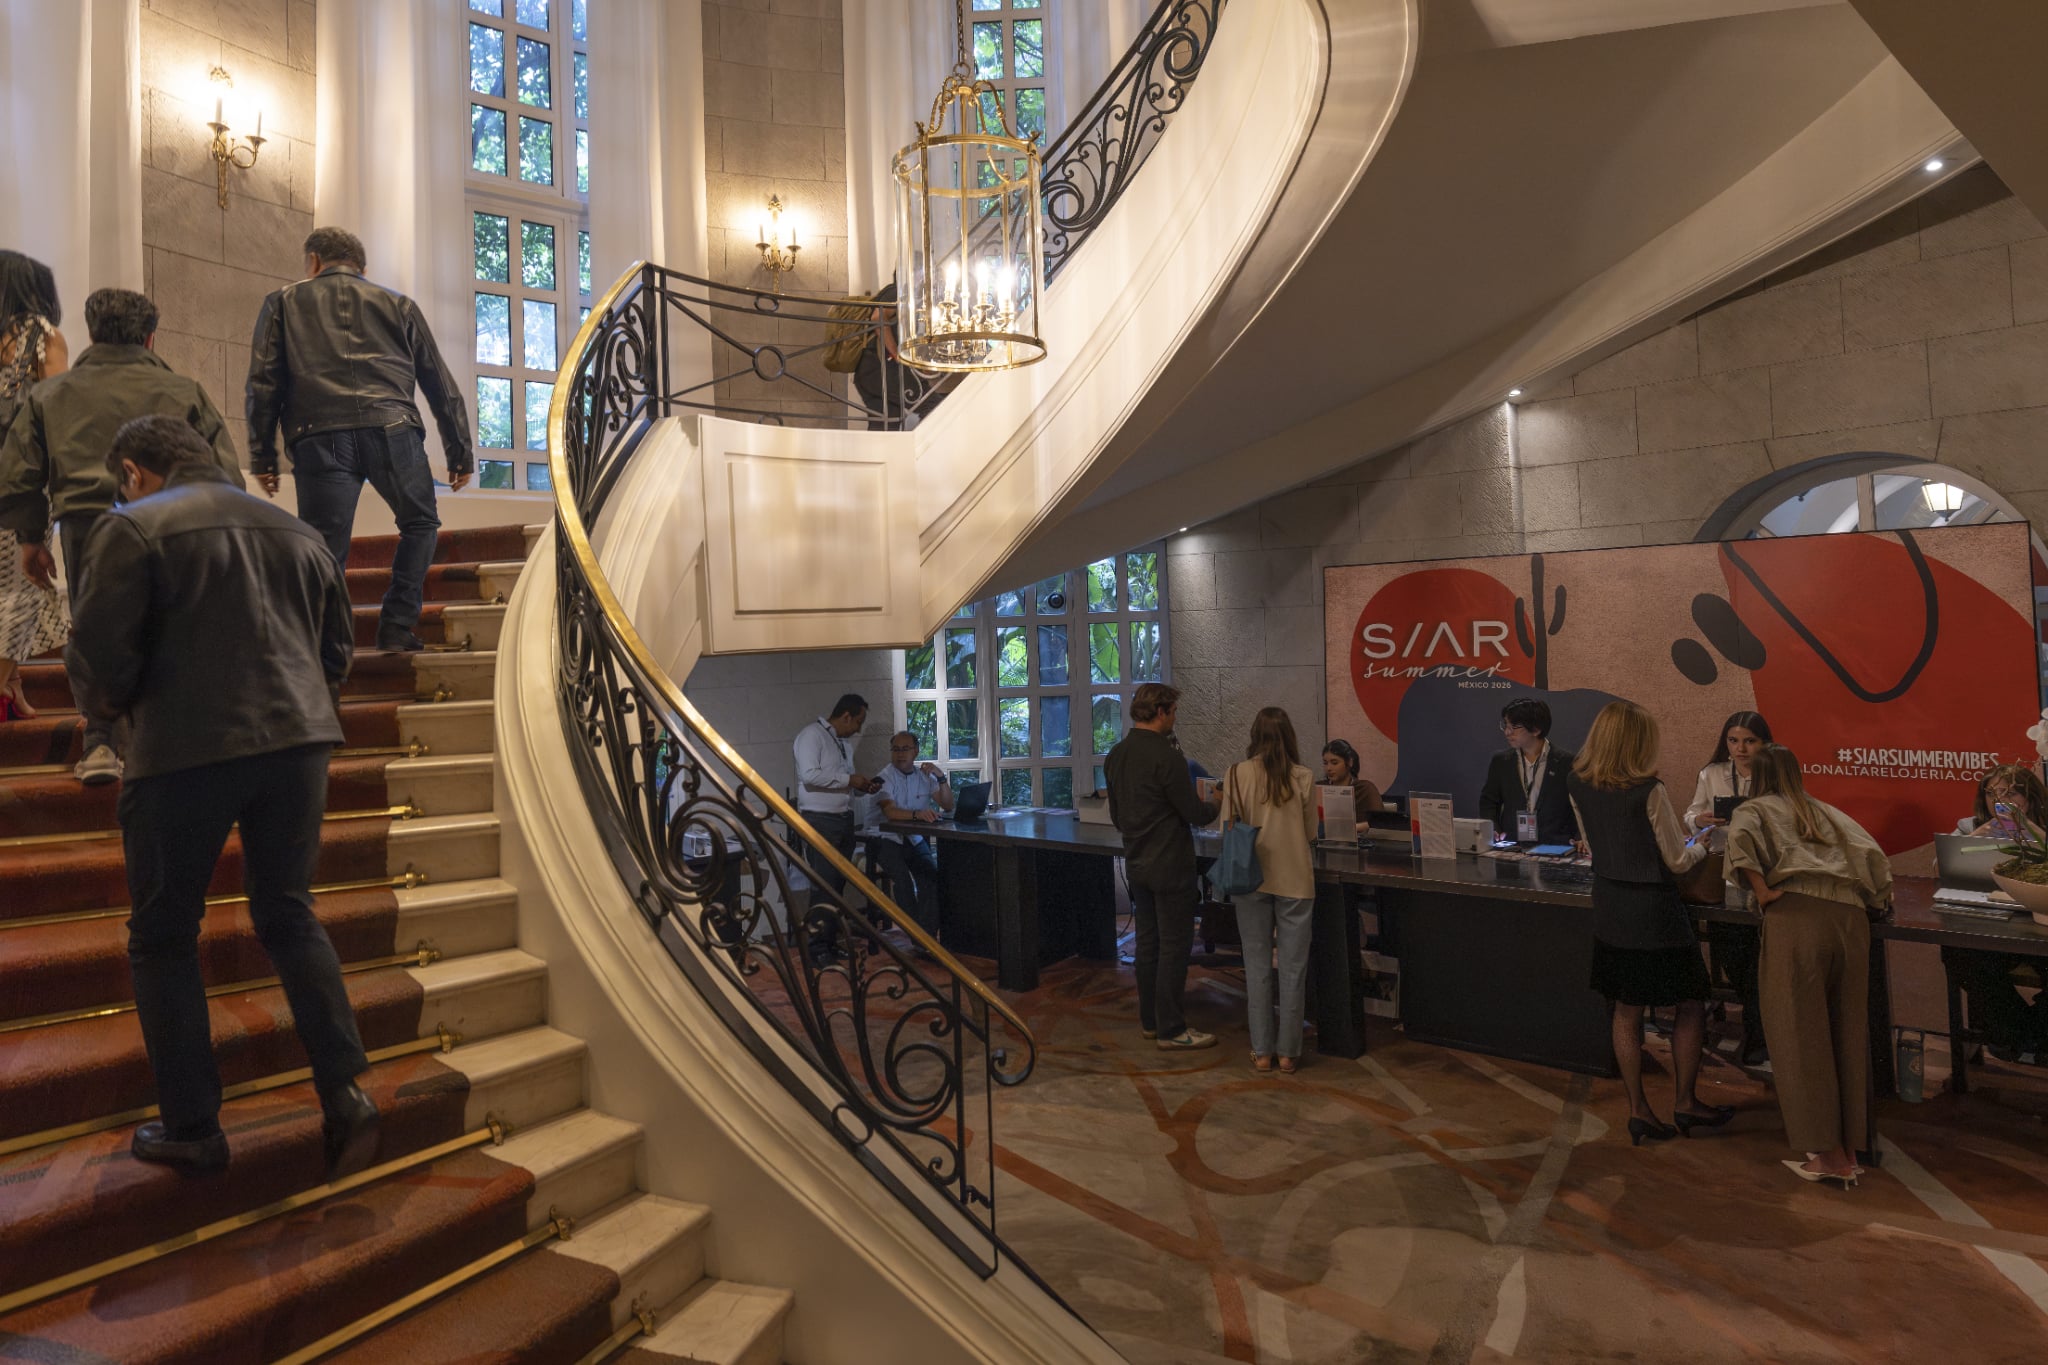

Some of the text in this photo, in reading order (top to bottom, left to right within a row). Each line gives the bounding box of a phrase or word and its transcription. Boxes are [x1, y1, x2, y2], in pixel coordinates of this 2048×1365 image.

[1363, 661, 1511, 679] summer
[1458, 681, 1489, 689] MÉXICO
[1837, 747, 2000, 770] #SIARSUMMERVIBES
[1800, 763, 1985, 782] LONALTARELOJERIA.CO
